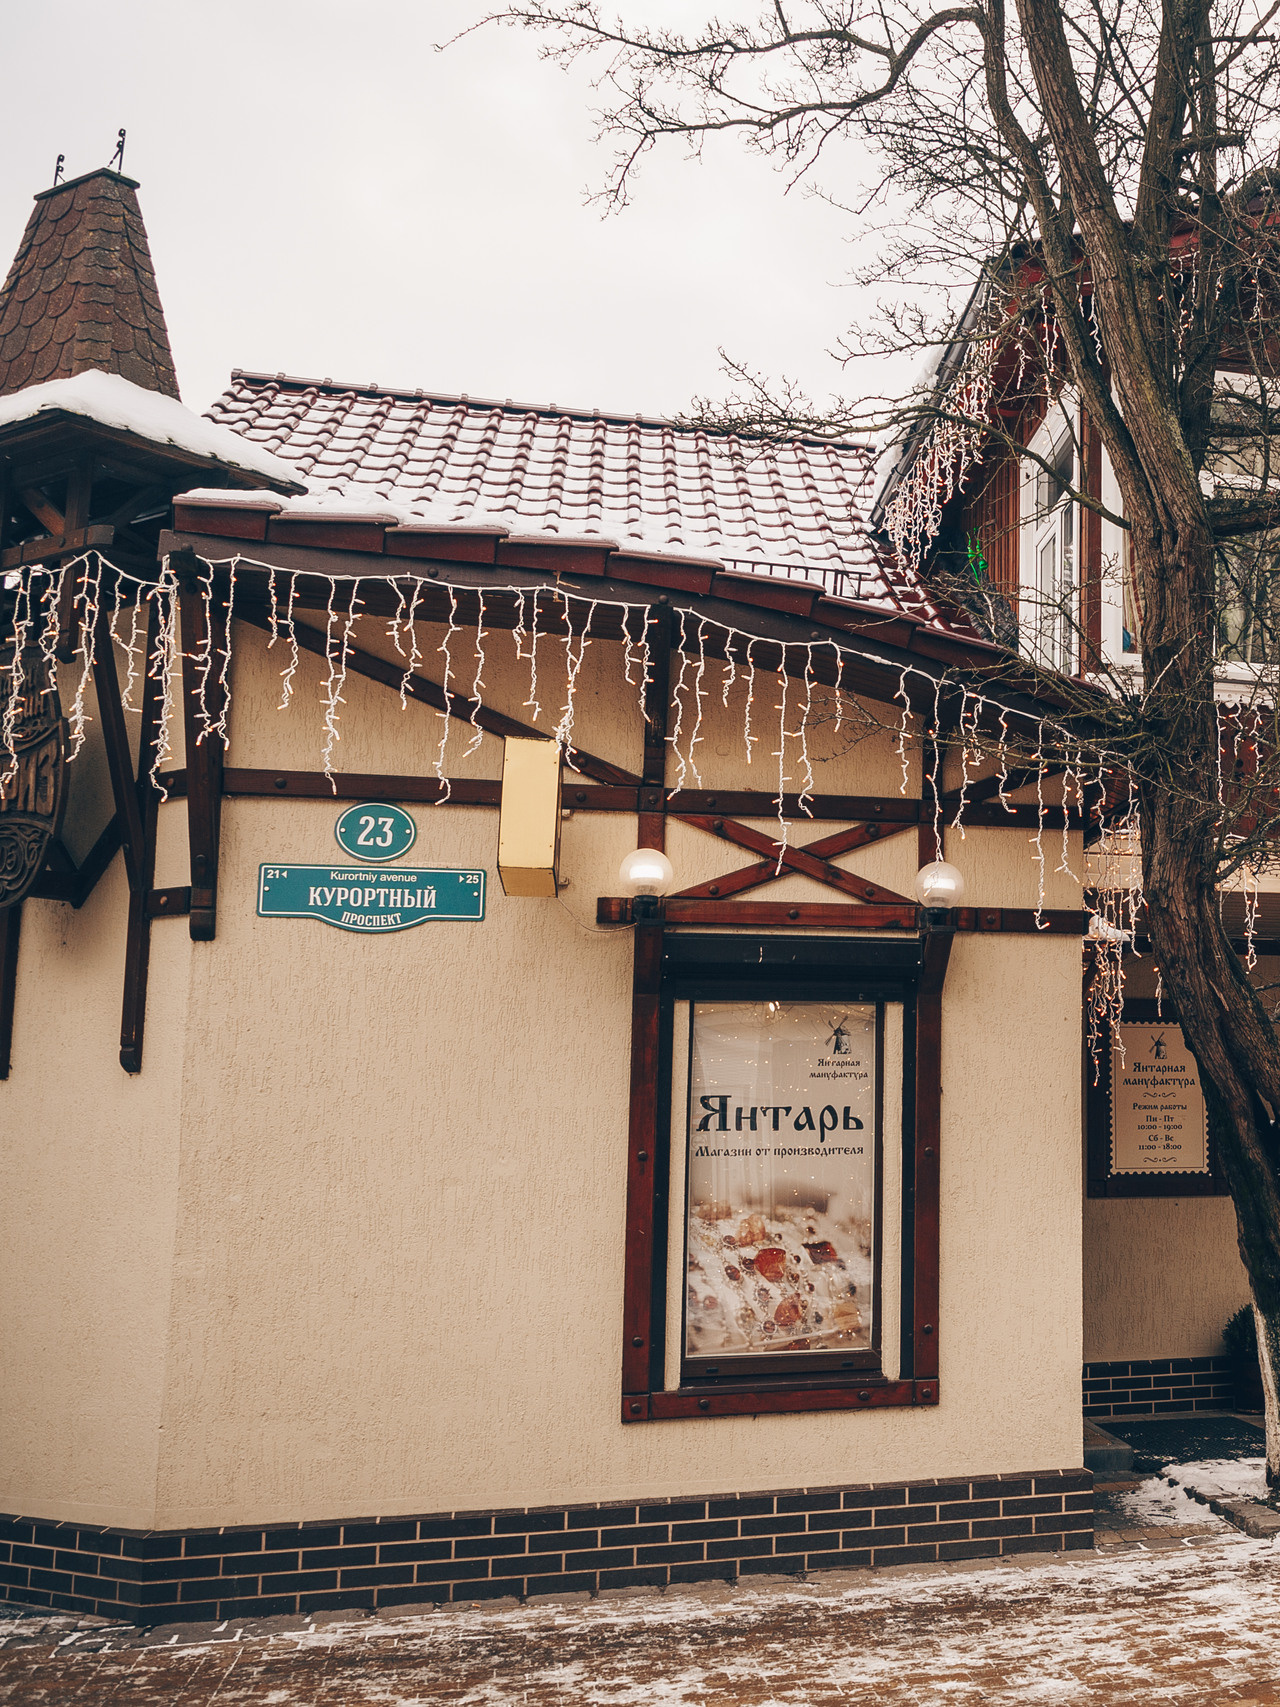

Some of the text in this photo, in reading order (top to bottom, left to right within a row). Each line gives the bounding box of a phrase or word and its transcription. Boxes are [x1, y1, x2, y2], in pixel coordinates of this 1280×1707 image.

[356, 815, 394, 848] 23
[266, 869, 280, 879] 21
[330, 871, 417, 884] Kurortniy avenue
[465, 874, 480, 884] 25
[308, 885, 437, 909] КУРОРТНЫЙ
[340, 910, 402, 927] ПРОСПЕКТ
[817, 1058, 861, 1069] Янтарная
[1132, 1062, 1186, 1075] Янтарная
[808, 1069, 869, 1081] мануфактура
[1122, 1075, 1196, 1089] мануфактура
[1132, 1102, 1188, 1112] Режим работы
[695, 1094, 864, 1144] Янтарь
[1145, 1115, 1158, 1123] Пн
[1163, 1115, 1174, 1123] Пт
[1148, 1134, 1159, 1142] Сб
[695, 1145, 864, 1159] Магазин от производителя
